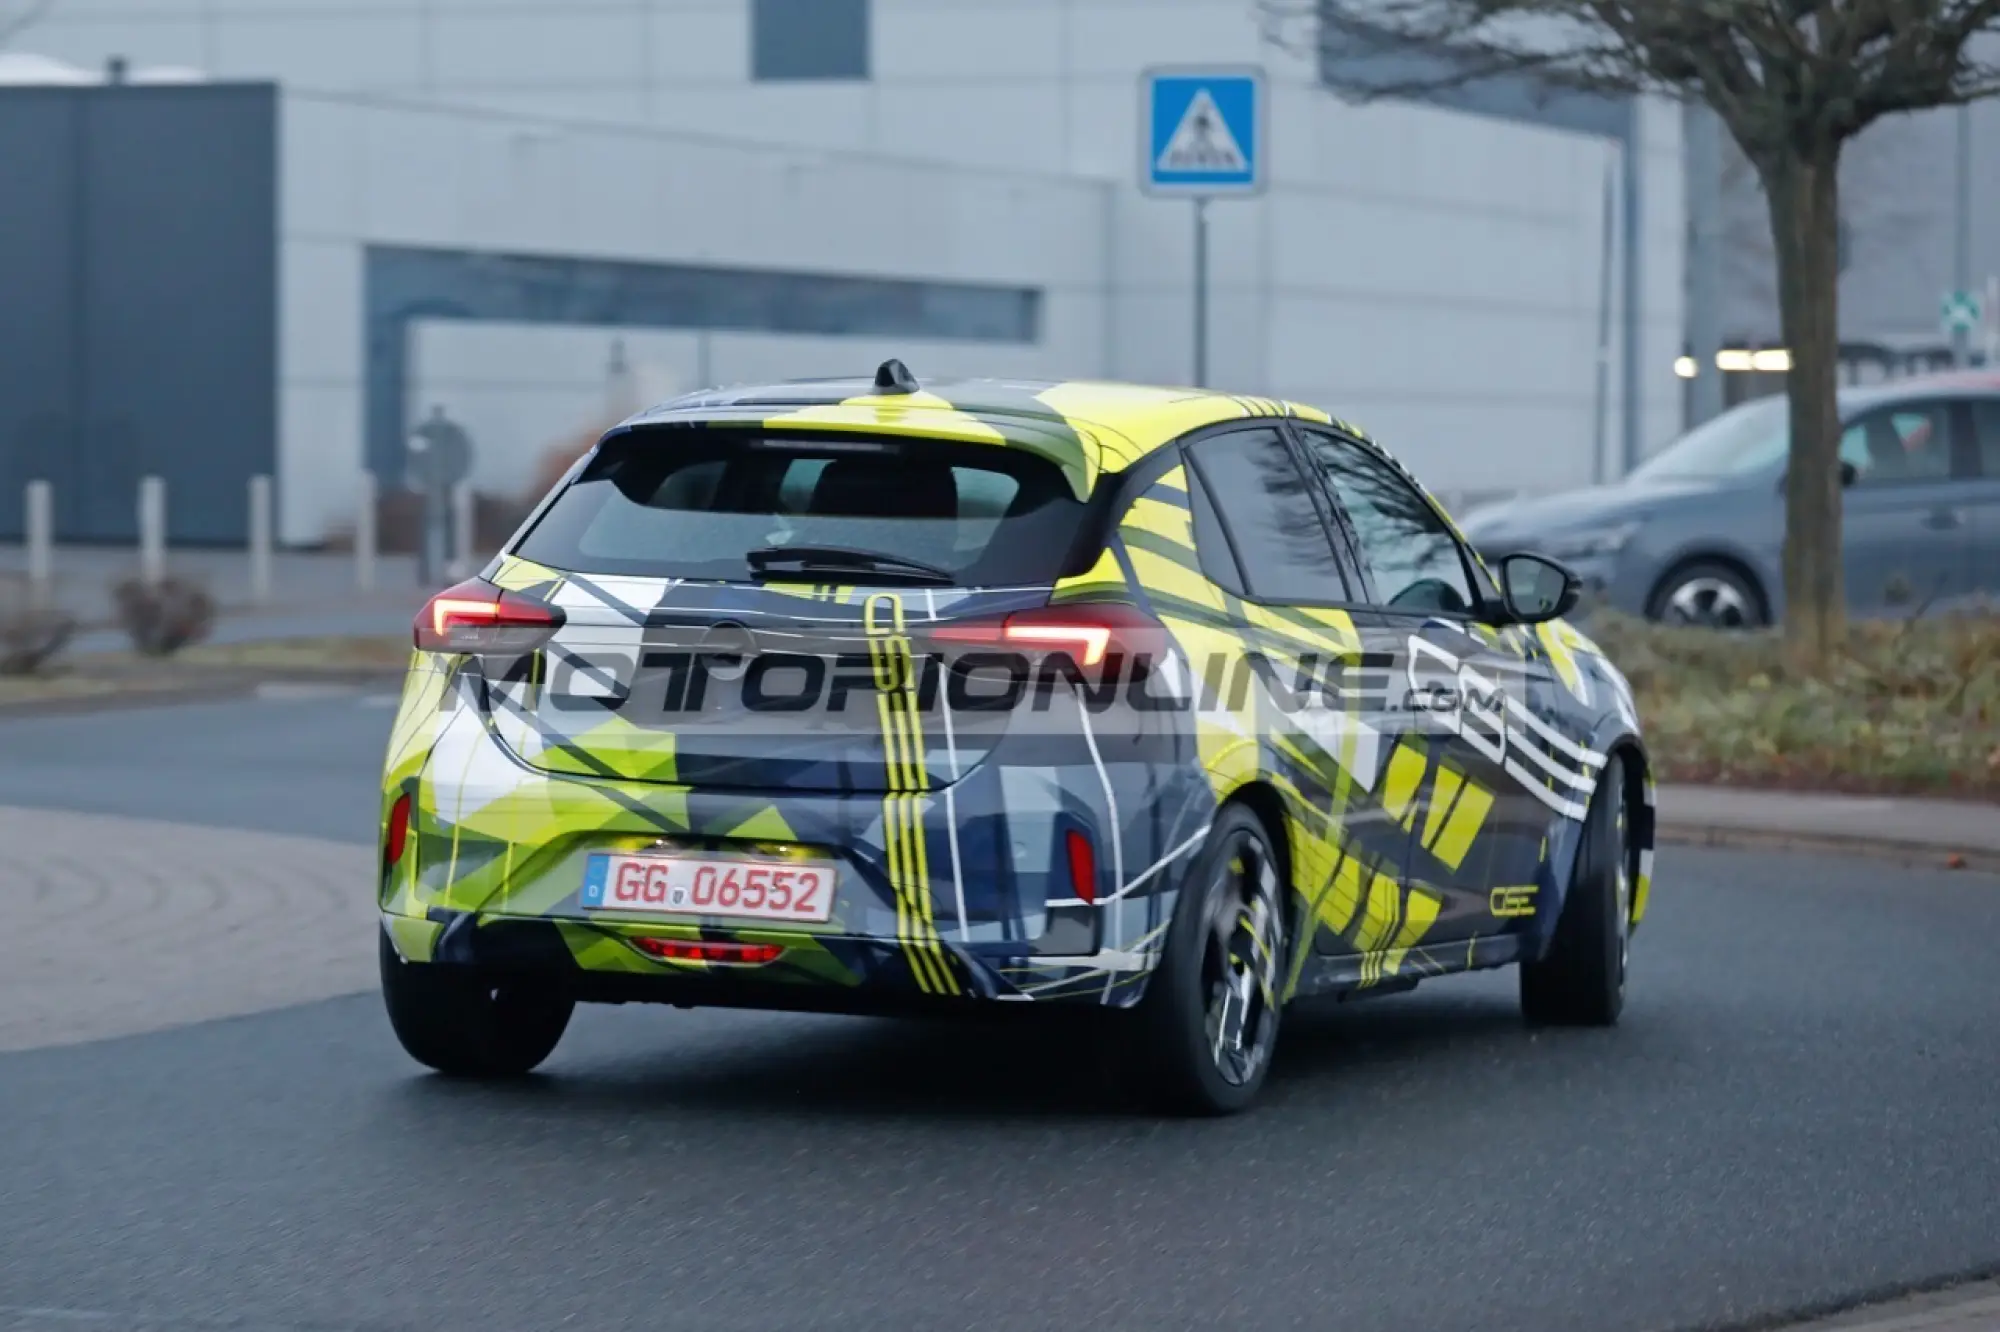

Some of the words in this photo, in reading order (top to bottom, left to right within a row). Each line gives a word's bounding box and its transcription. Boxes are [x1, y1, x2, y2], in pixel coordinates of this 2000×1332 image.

[588, 884, 599, 898] D
[616, 862, 668, 903] GG
[692, 866, 819, 913] 06552
